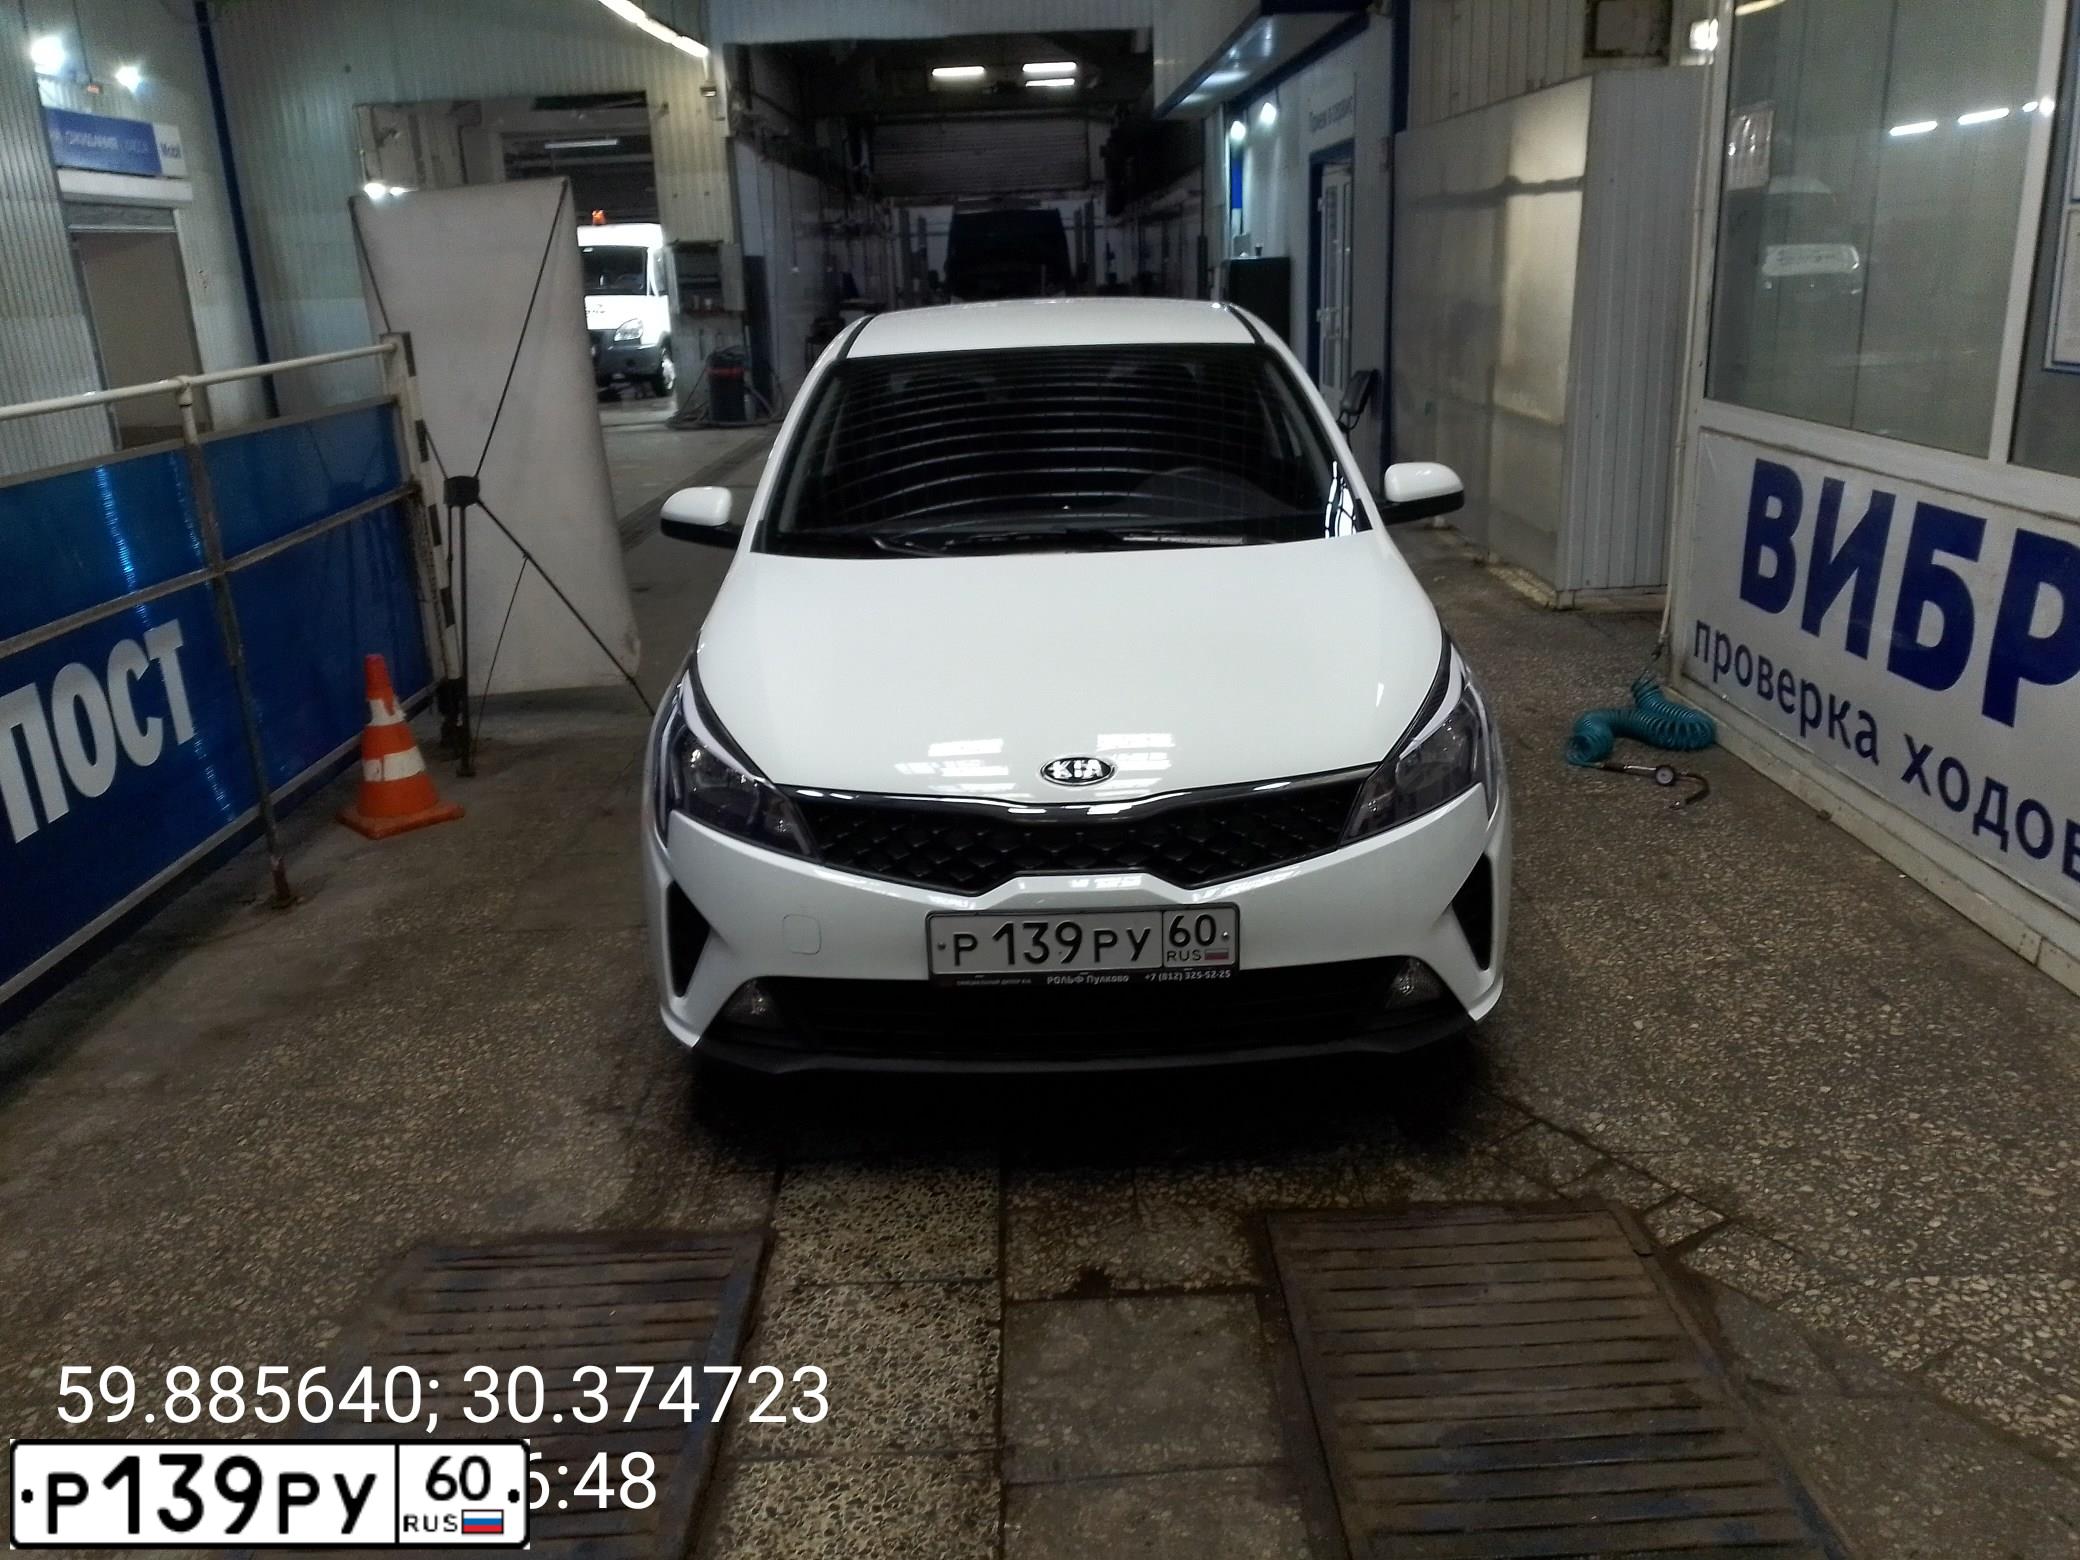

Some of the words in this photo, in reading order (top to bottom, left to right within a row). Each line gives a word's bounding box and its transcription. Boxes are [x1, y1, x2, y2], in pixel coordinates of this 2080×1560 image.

[1740, 458, 2080, 728] ВИБР
[0, 618, 196, 844] ПОСТ
[1693, 620, 1879, 766] проверка
[1051, 759, 1104, 779] KIA
[1166, 950, 1202, 962] RUS
[1168, 914, 1217, 948] 60
